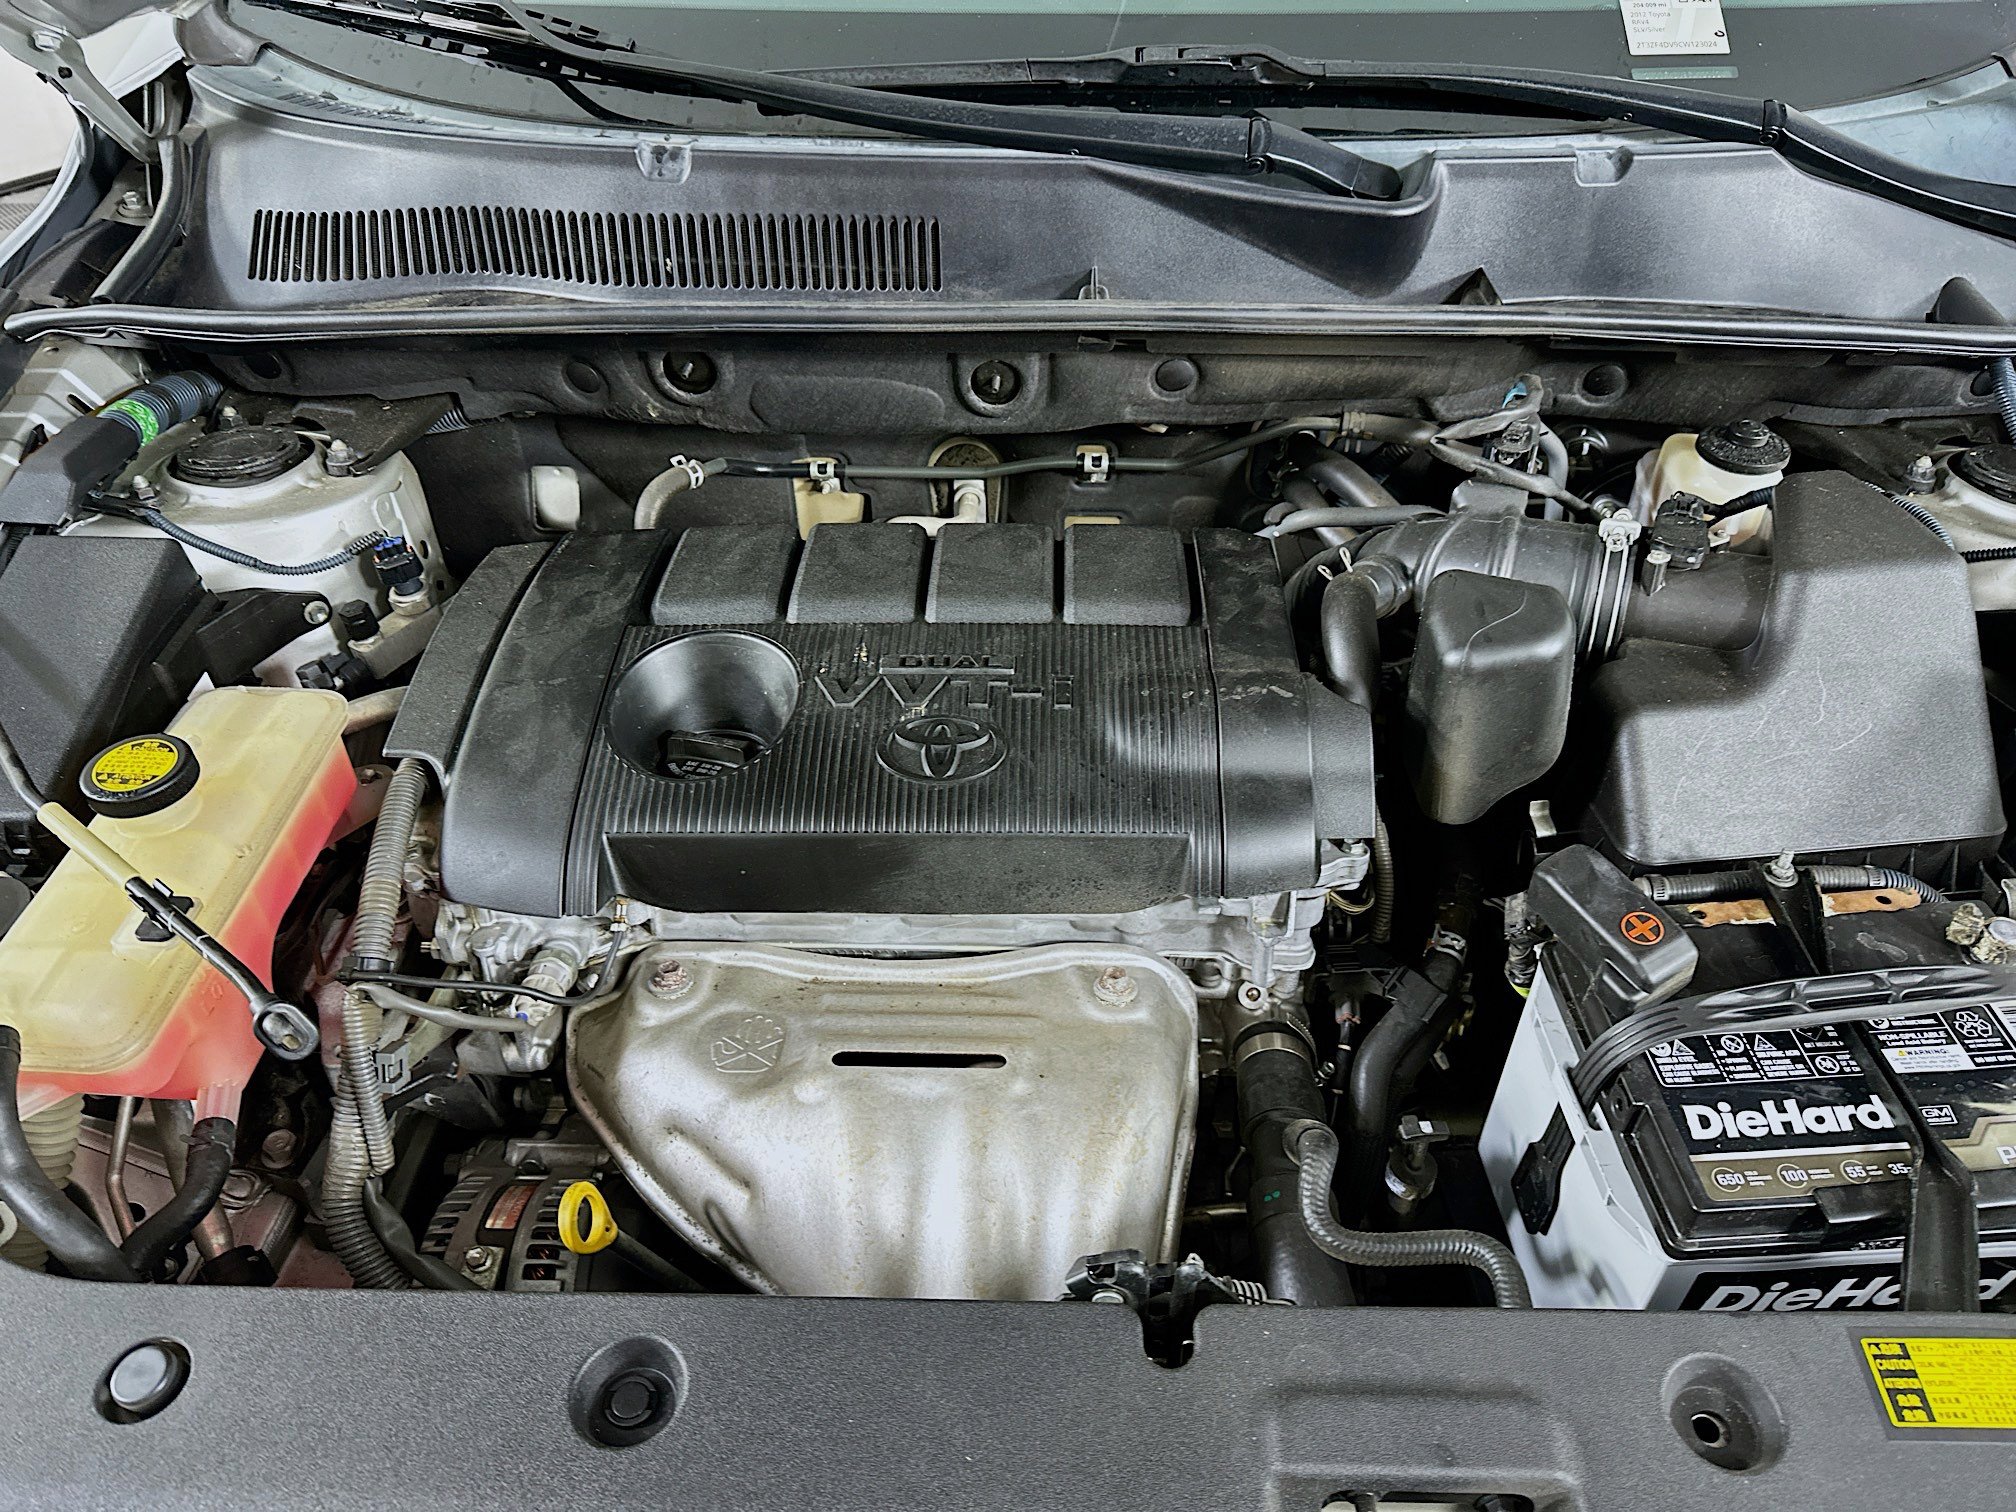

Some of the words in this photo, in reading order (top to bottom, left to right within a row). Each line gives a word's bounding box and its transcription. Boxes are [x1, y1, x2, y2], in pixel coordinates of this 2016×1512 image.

[1649, 11, 1671, 19] Toyota
[898, 654, 1003, 668] DUAL
[1681, 1094, 1895, 1141] DieHard
[1780, 1169, 1809, 1182] 100
[1845, 1165, 1867, 1178] 55
[1715, 1173, 1746, 1187] 650
